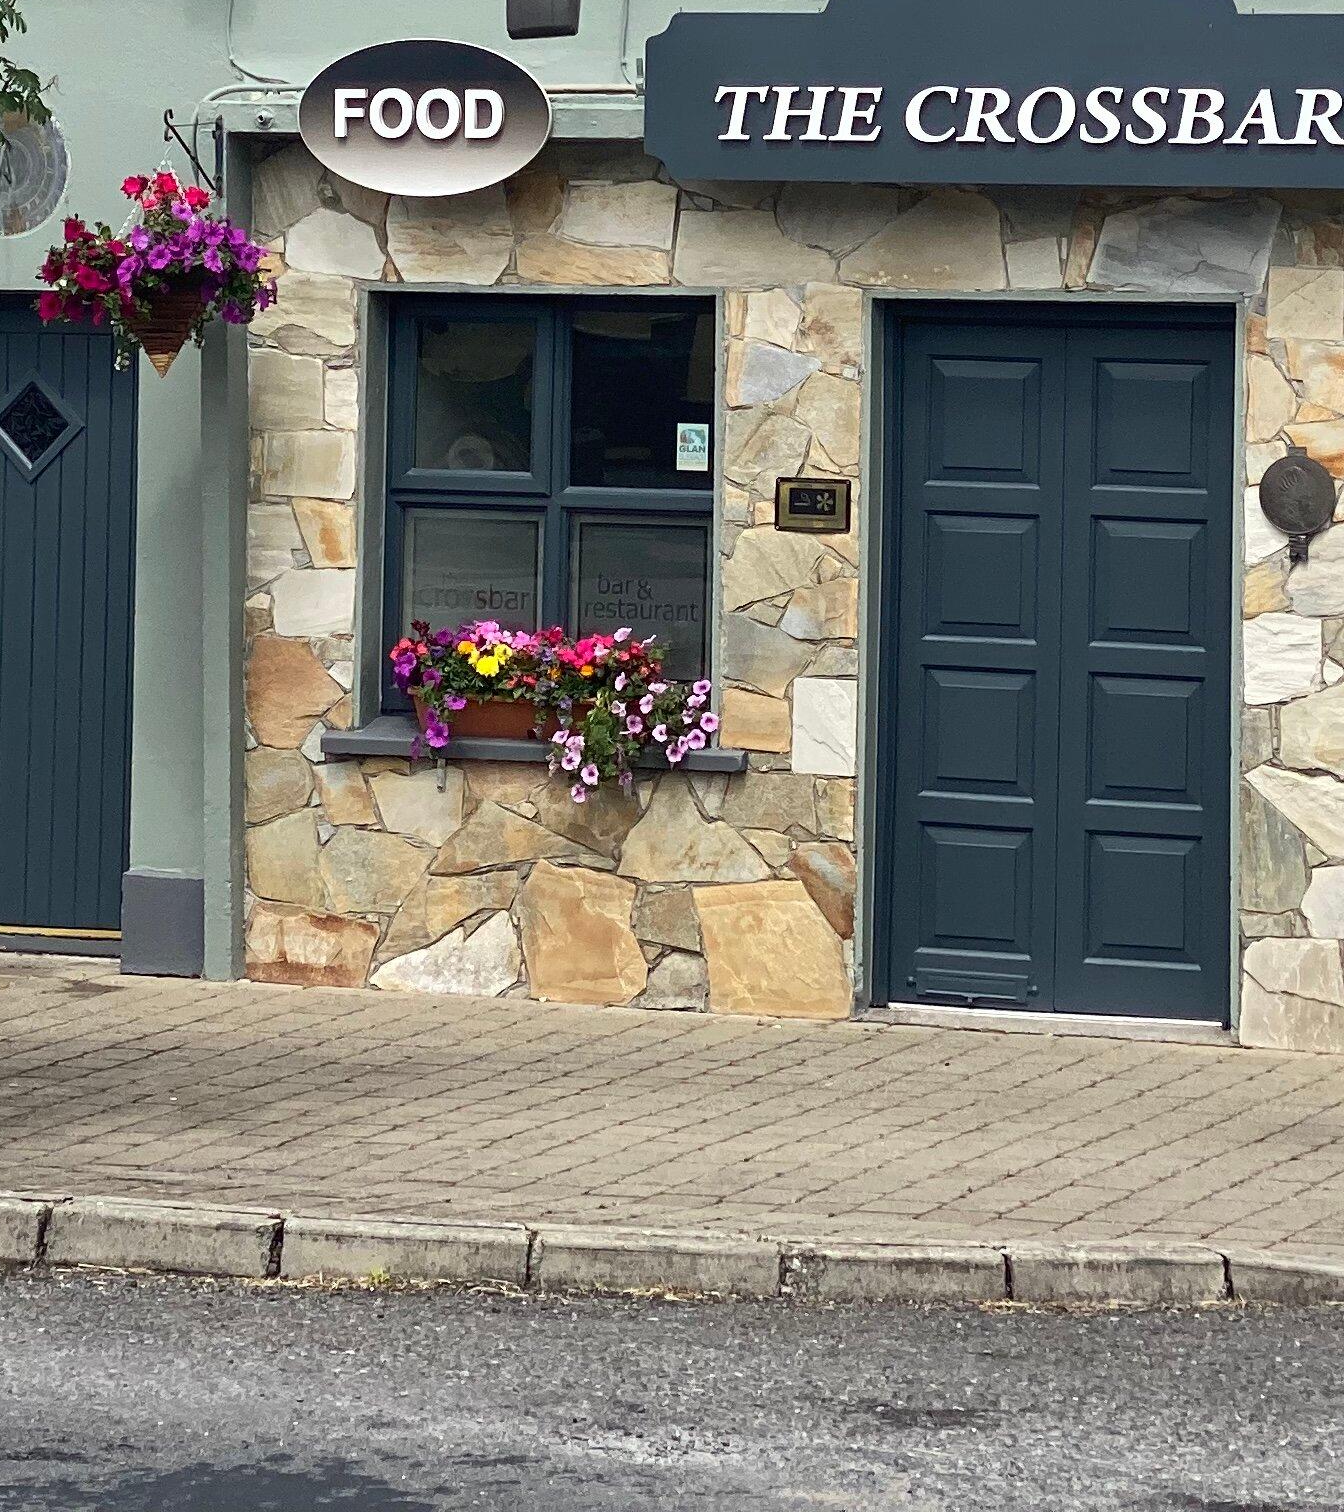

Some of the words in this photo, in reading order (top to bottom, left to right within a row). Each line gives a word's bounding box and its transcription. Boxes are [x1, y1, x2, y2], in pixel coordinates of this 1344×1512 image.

[332, 87, 506, 143] FOOD
[713, 85, 884, 143] THE
[678, 445, 707, 454] GLAN
[597, 572, 633, 595] bar
[636, 578, 653, 601] &
[584, 599, 699, 623] restaurant
